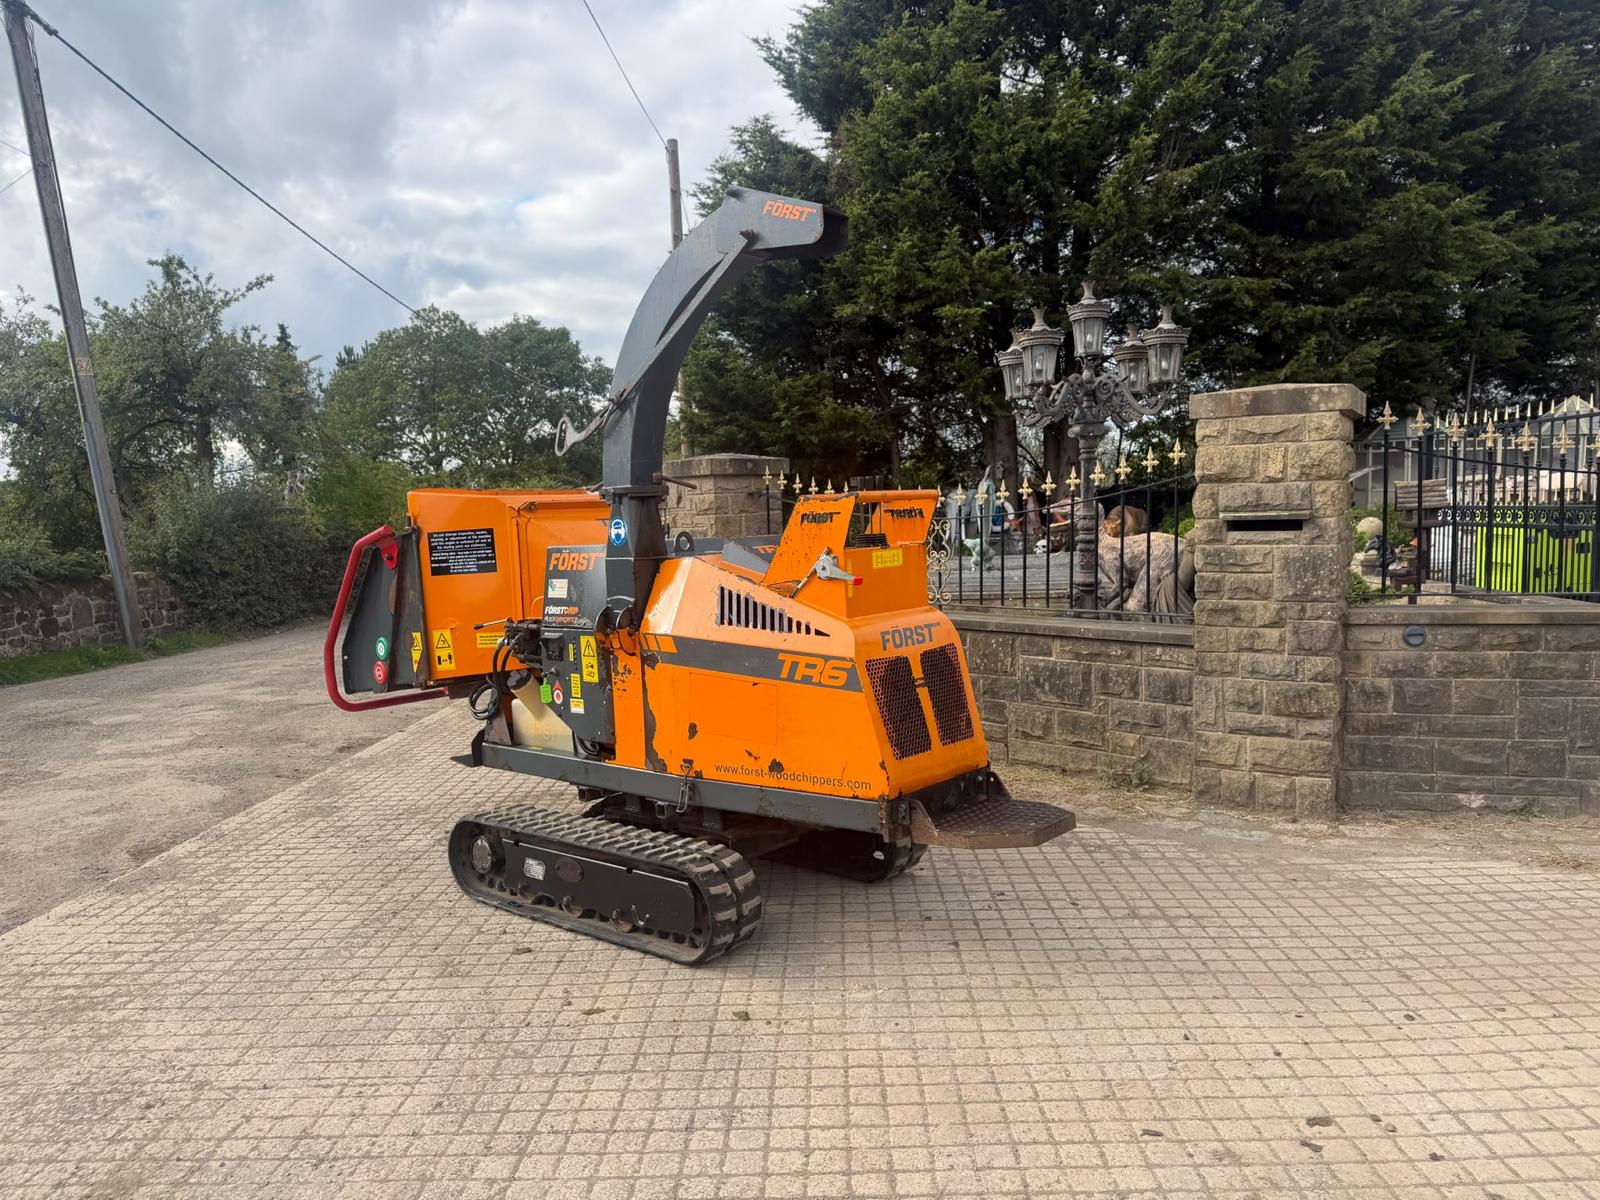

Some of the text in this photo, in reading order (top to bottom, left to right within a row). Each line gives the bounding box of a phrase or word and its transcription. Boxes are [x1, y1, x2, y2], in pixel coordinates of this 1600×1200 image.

[763, 200, 814, 222] FÖRST
[548, 550, 603, 570] FÖRST
[880, 623, 938, 651] FÖRST
[777, 652, 852, 686] TR6
[714, 763, 872, 790] www.forst-woodchippers.com
